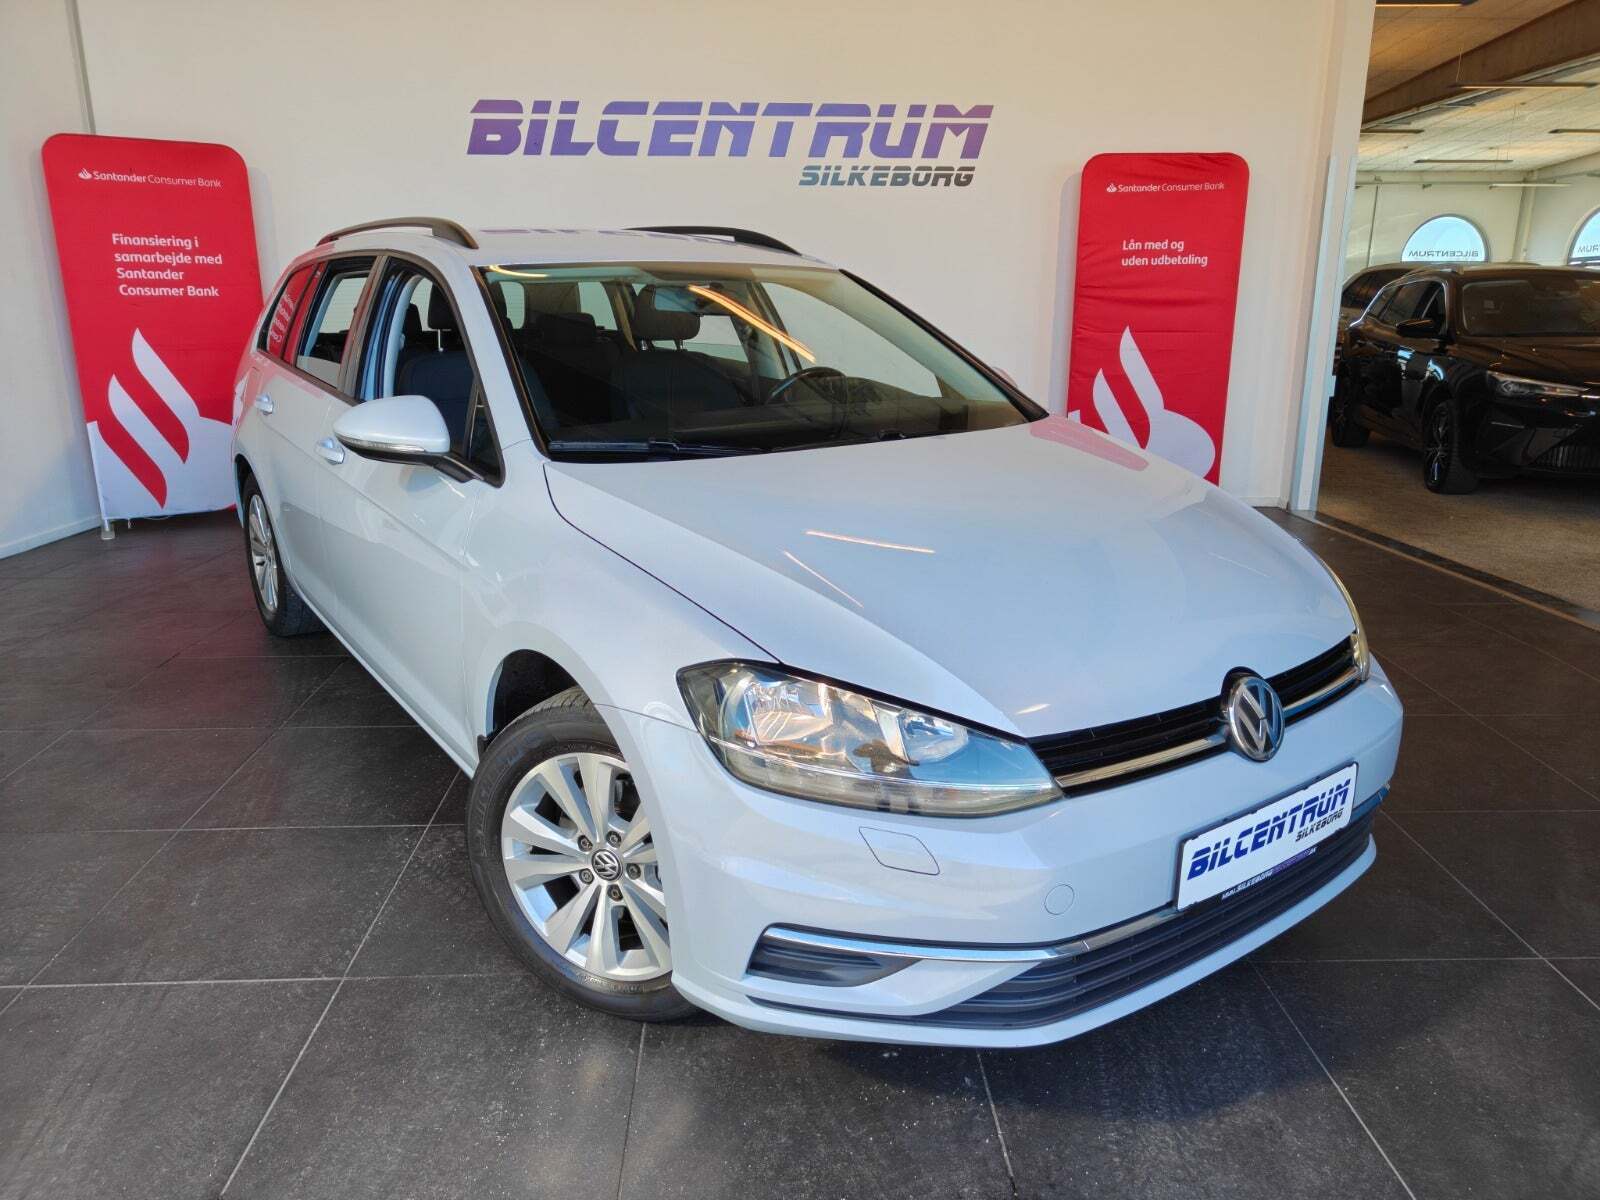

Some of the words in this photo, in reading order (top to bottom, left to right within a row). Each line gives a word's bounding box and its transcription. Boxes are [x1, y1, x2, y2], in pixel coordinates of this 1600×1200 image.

[466, 99, 994, 159] BILCENTRUM
[93, 170, 146, 183] Santander
[147, 174, 196, 186] Consumer
[197, 177, 221, 188] Bank
[799, 165, 976, 187] SILKEBORG
[1118, 183, 1161, 193] Santander
[1161, 182, 1203, 192] Consumer
[1204, 181, 1225, 191] Bank
[111, 233, 192, 250] Finansiering
[194, 236, 199, 247] i
[1122, 238, 1142, 250] Lån
[1144, 239, 1169, 250] med
[1170, 240, 1184, 252] og
[114, 252, 192, 266] samarbejde
[194, 253, 223, 264] med
[1121, 255, 1149, 267] uden
[1151, 253, 1208, 267] udbetaling
[116, 267, 185, 280] Santander
[119, 284, 185, 297] Consumer
[186, 285, 220, 297] Bank
[1187, 778, 1351, 880] BILCENTRUM
[1295, 808, 1344, 842] SILKEBORG
